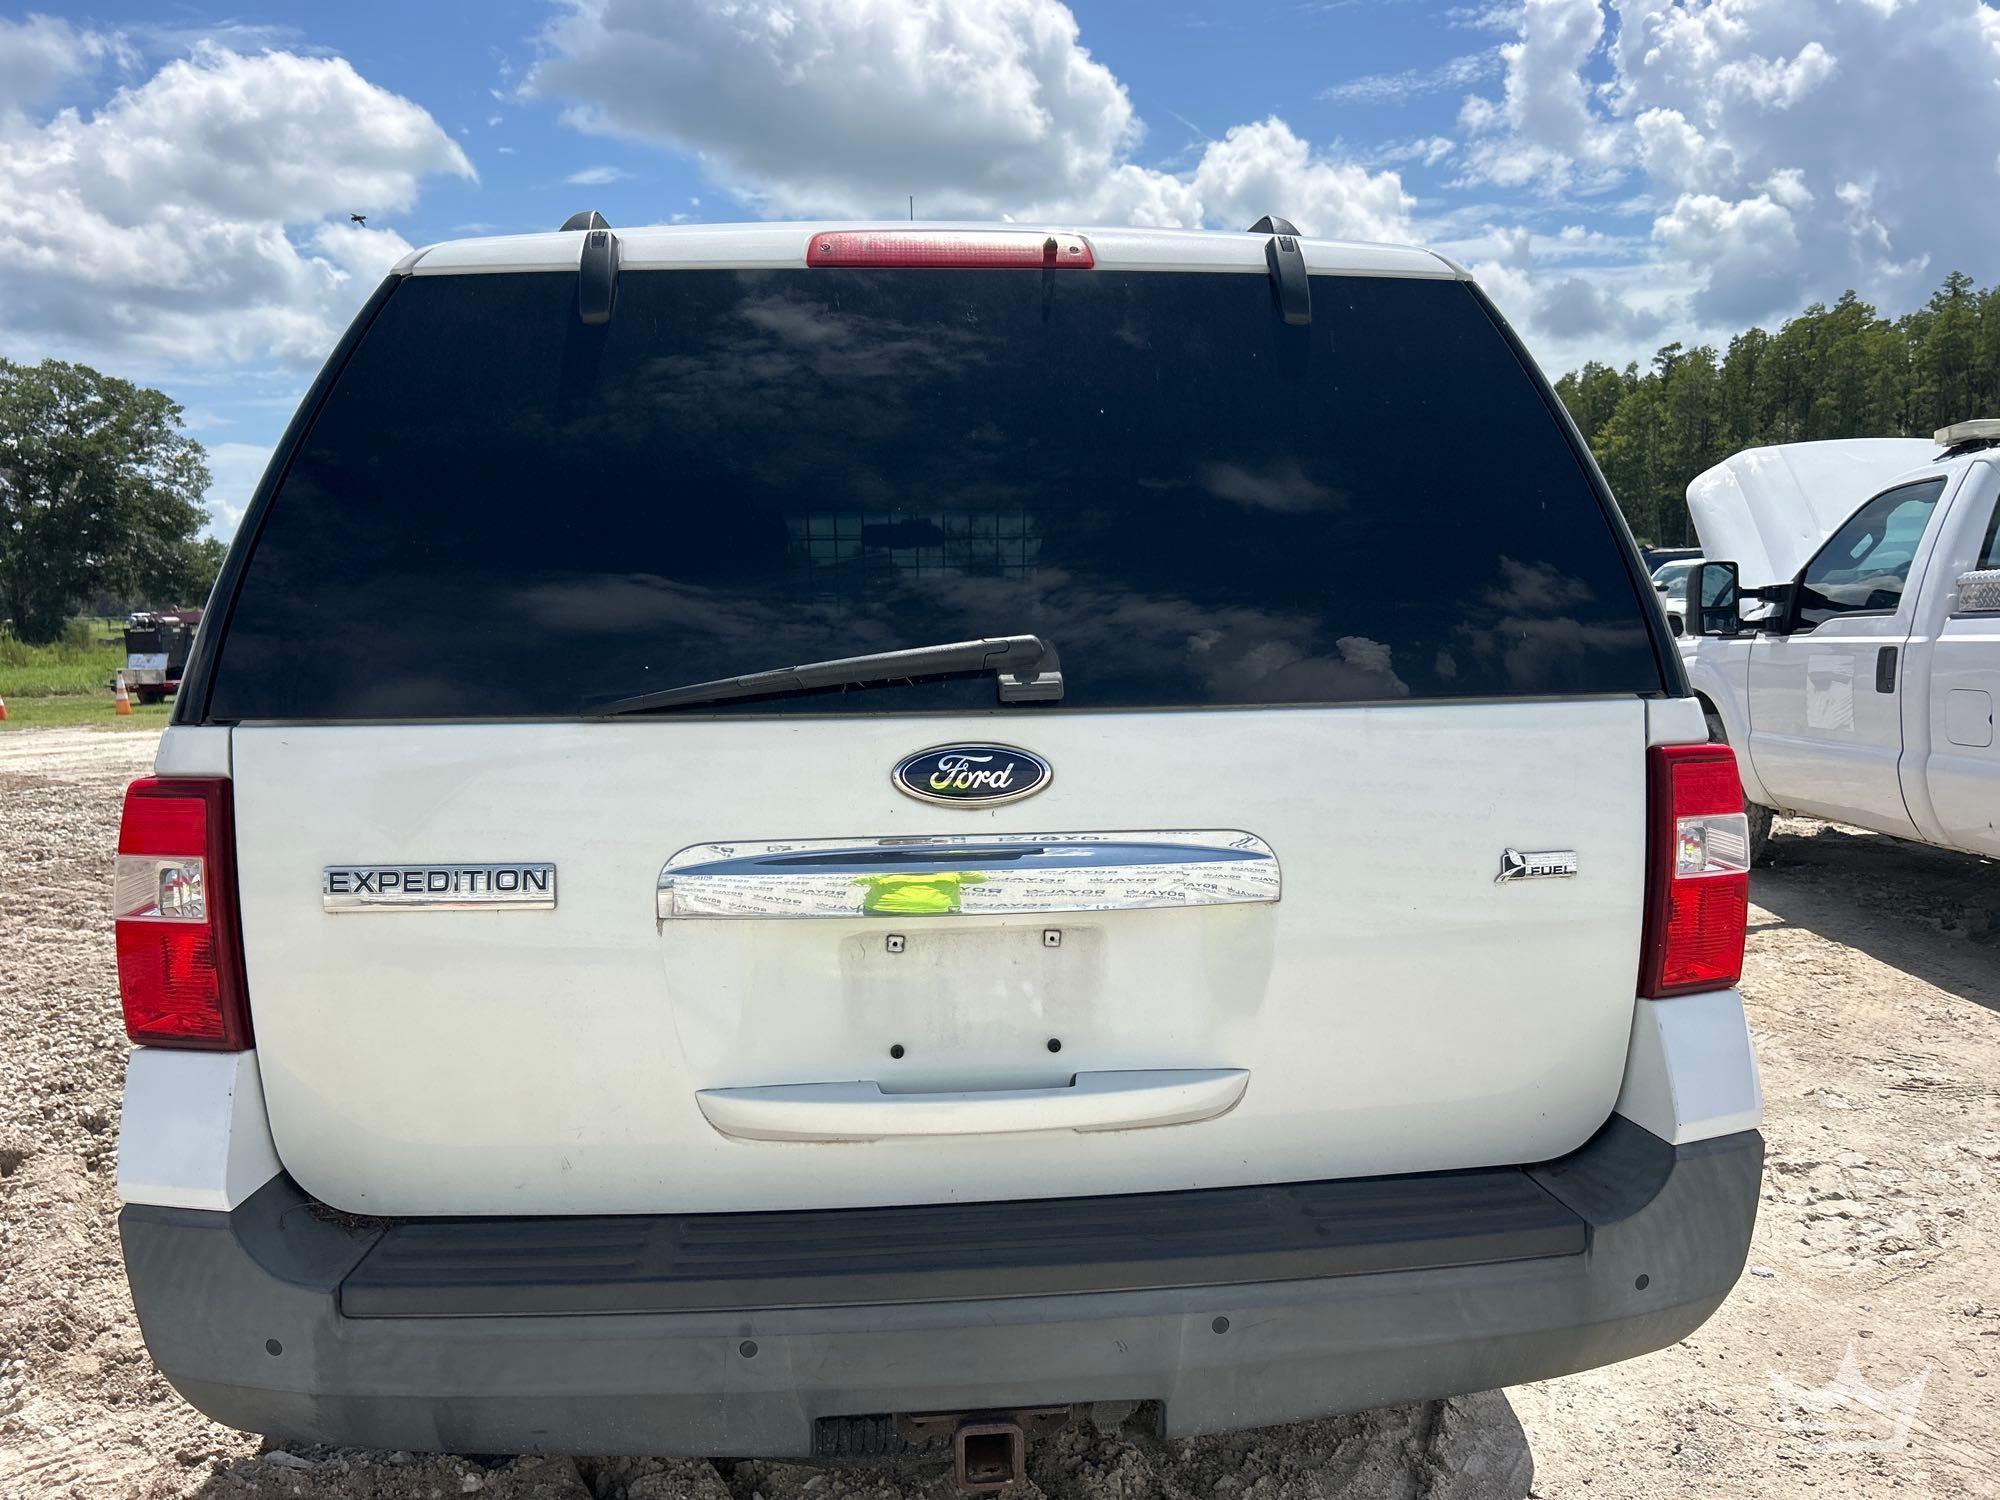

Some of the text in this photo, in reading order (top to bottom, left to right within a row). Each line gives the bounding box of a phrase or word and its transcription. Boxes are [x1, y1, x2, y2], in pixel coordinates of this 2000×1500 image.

[930, 755, 1014, 790] Ford
[328, 869, 548, 893] EXPEDITION
[1531, 865, 1572, 876] FUEL
